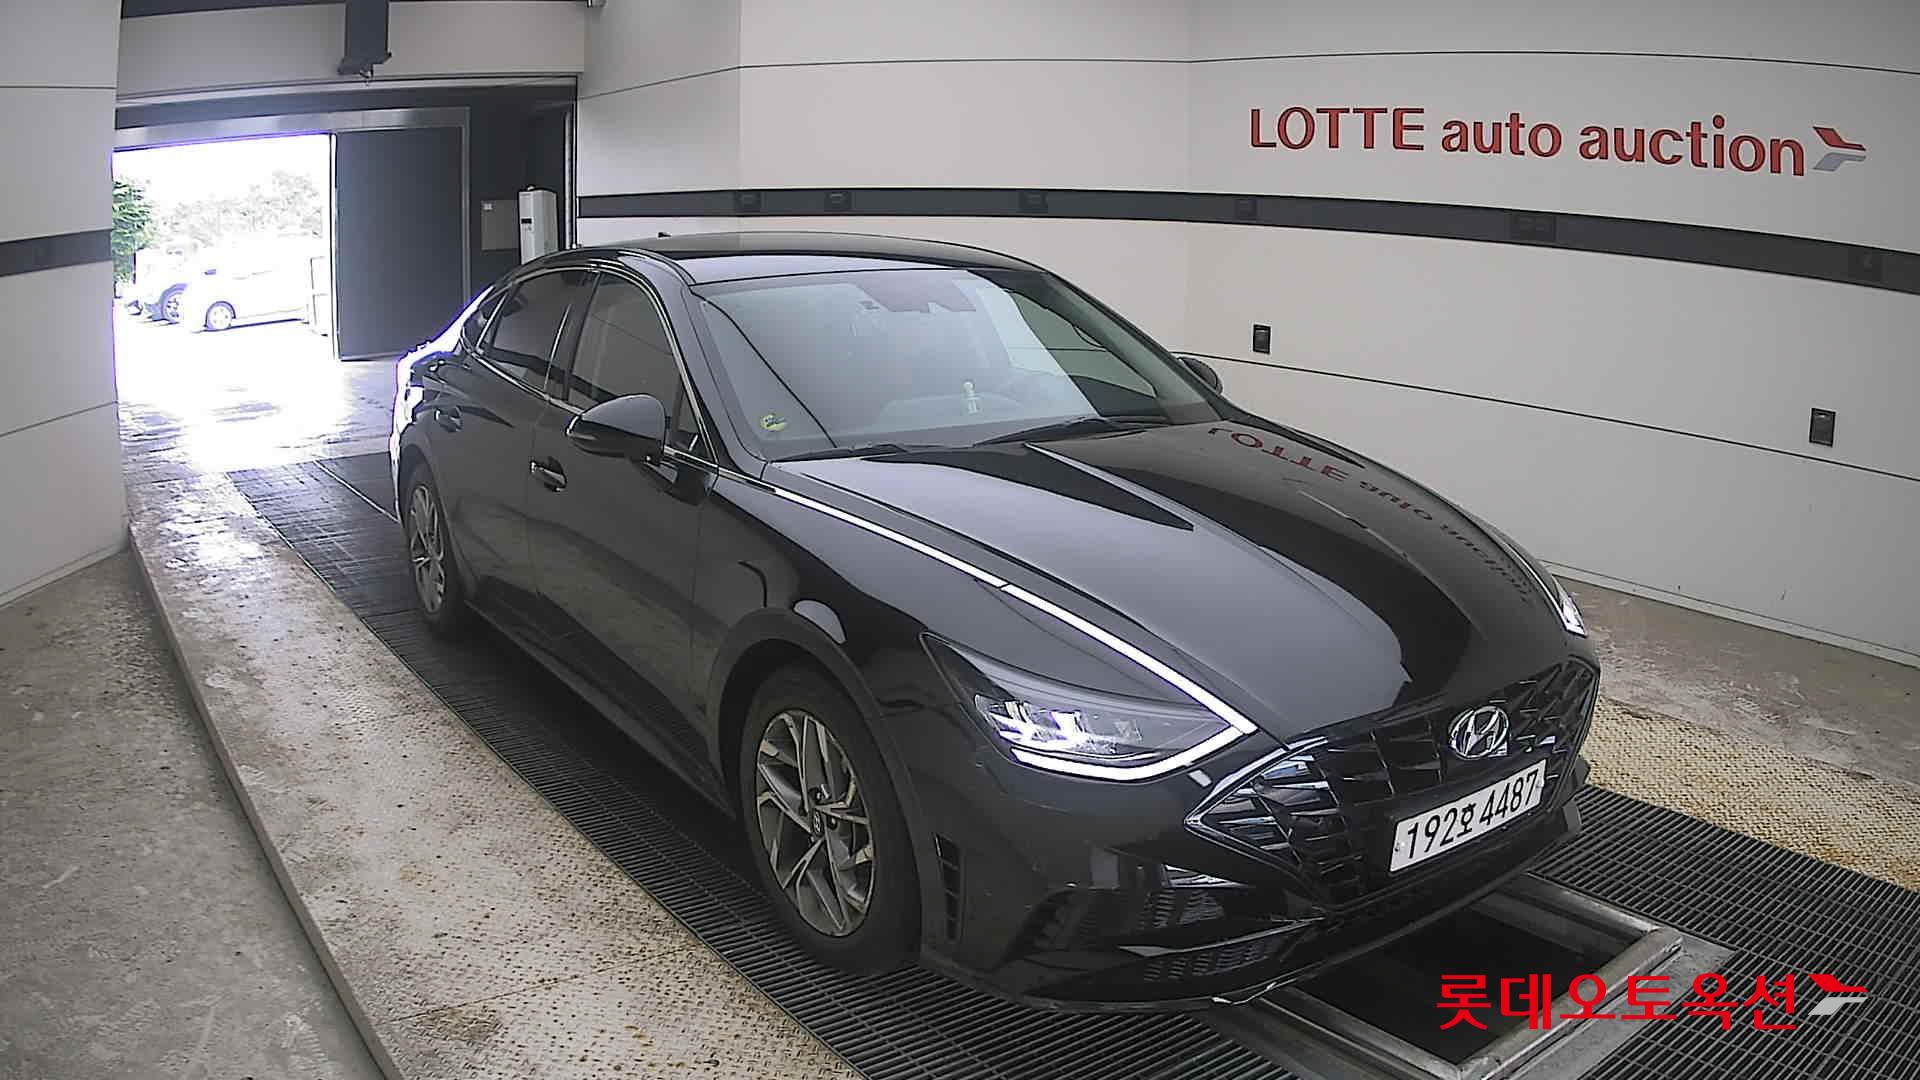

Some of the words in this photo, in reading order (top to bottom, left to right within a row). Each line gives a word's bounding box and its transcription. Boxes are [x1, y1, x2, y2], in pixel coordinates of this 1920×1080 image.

[1250, 107, 1425, 152] LOTTE
[1442, 112, 1562, 157] auto
[1579, 115, 1805, 177] auction
[1407, 803, 1477, 859] 192호
[1479, 768, 1539, 826] 4487
